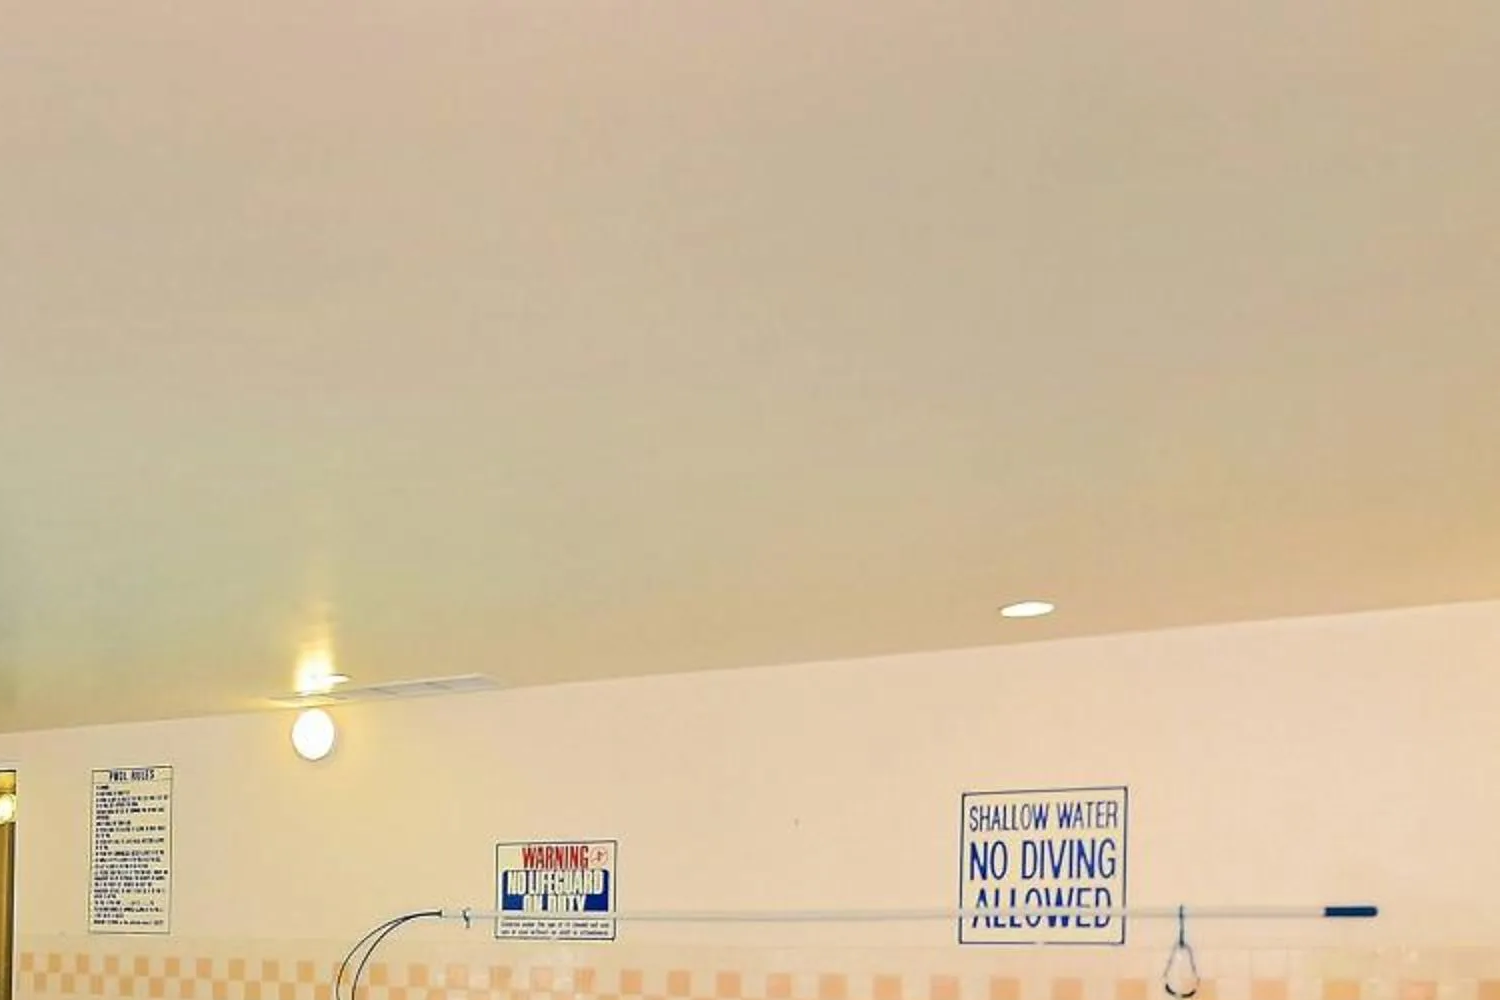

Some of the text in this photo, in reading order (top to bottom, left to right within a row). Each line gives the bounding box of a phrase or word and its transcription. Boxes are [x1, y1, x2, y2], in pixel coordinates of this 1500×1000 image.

[969, 801, 1118, 832] SHALLOW WATER
[522, 846, 589, 869] WARNING
[970, 838, 1116, 880] NO DIVING
[972, 888, 1112, 928] ALLOWED
